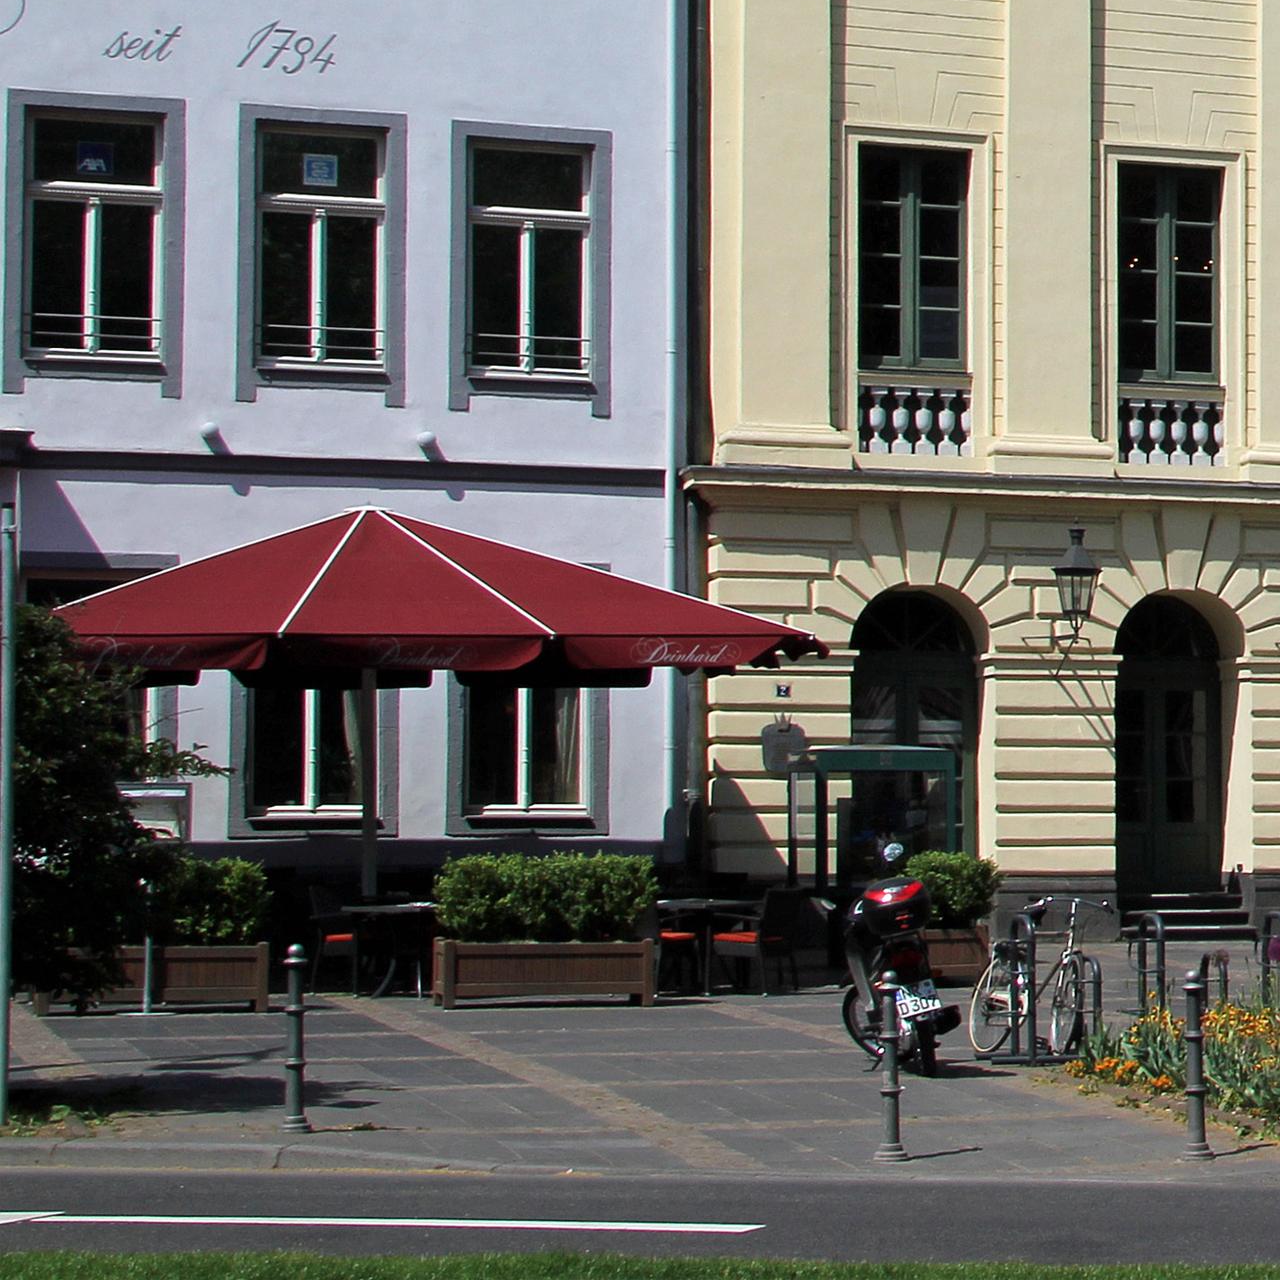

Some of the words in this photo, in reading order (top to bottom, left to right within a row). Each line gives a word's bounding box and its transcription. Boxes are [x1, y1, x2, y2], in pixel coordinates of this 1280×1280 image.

[102, 25, 183, 62] seit
[236, 20, 338, 74] 1794
[643, 639, 729, 664] Deinhard
[780, 686, 786, 696] 2
